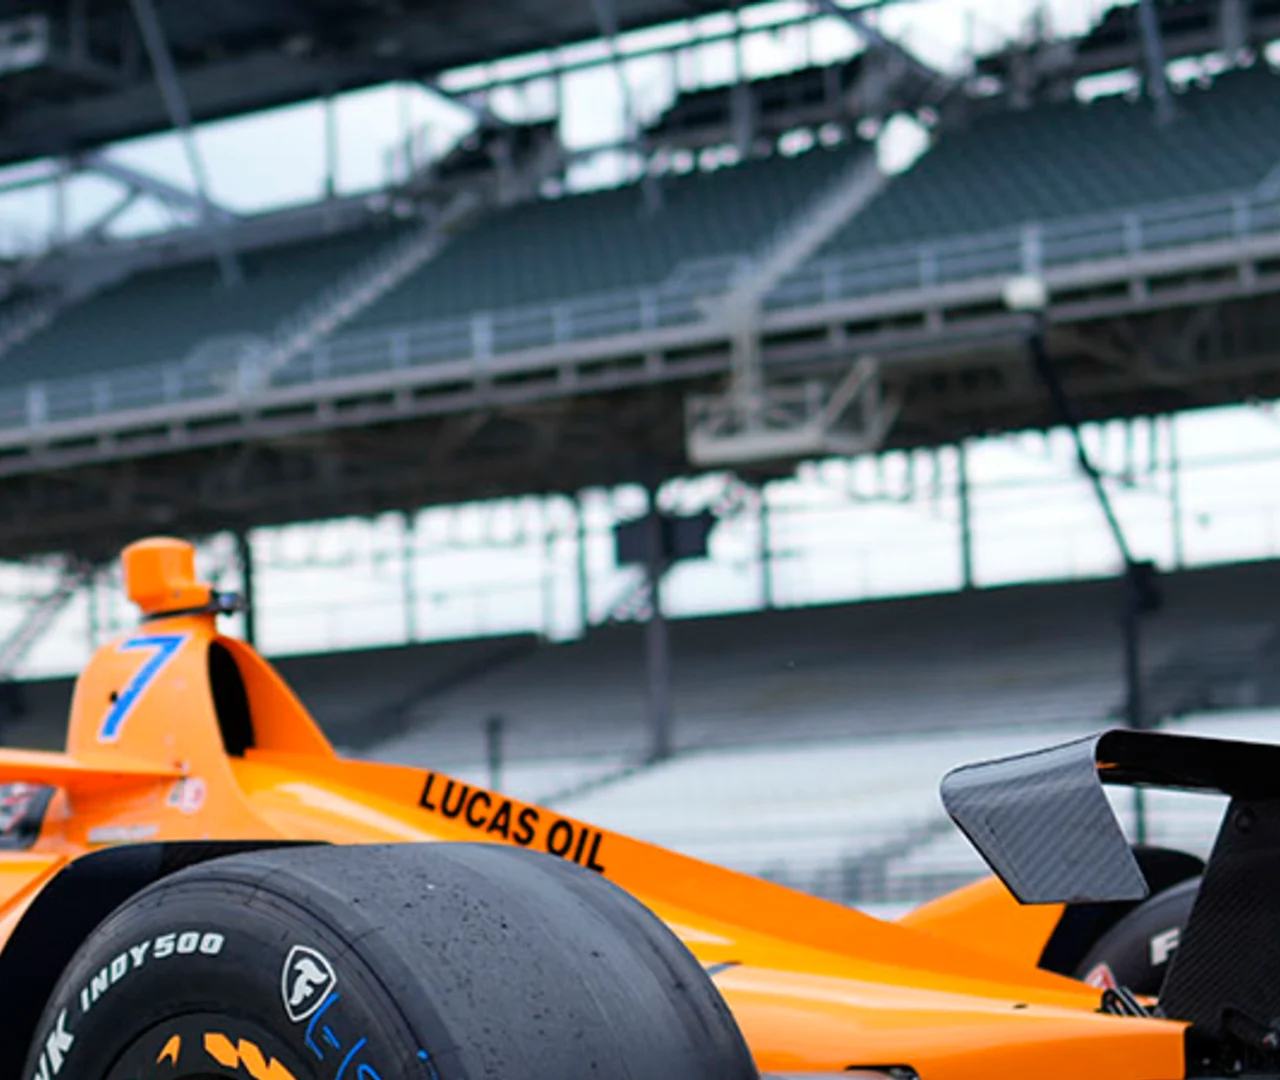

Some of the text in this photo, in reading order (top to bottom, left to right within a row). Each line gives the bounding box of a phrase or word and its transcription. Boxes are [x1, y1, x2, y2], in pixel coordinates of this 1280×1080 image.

[98, 633, 190, 742] 7
[419, 772, 606, 873] LUCAS OIL
